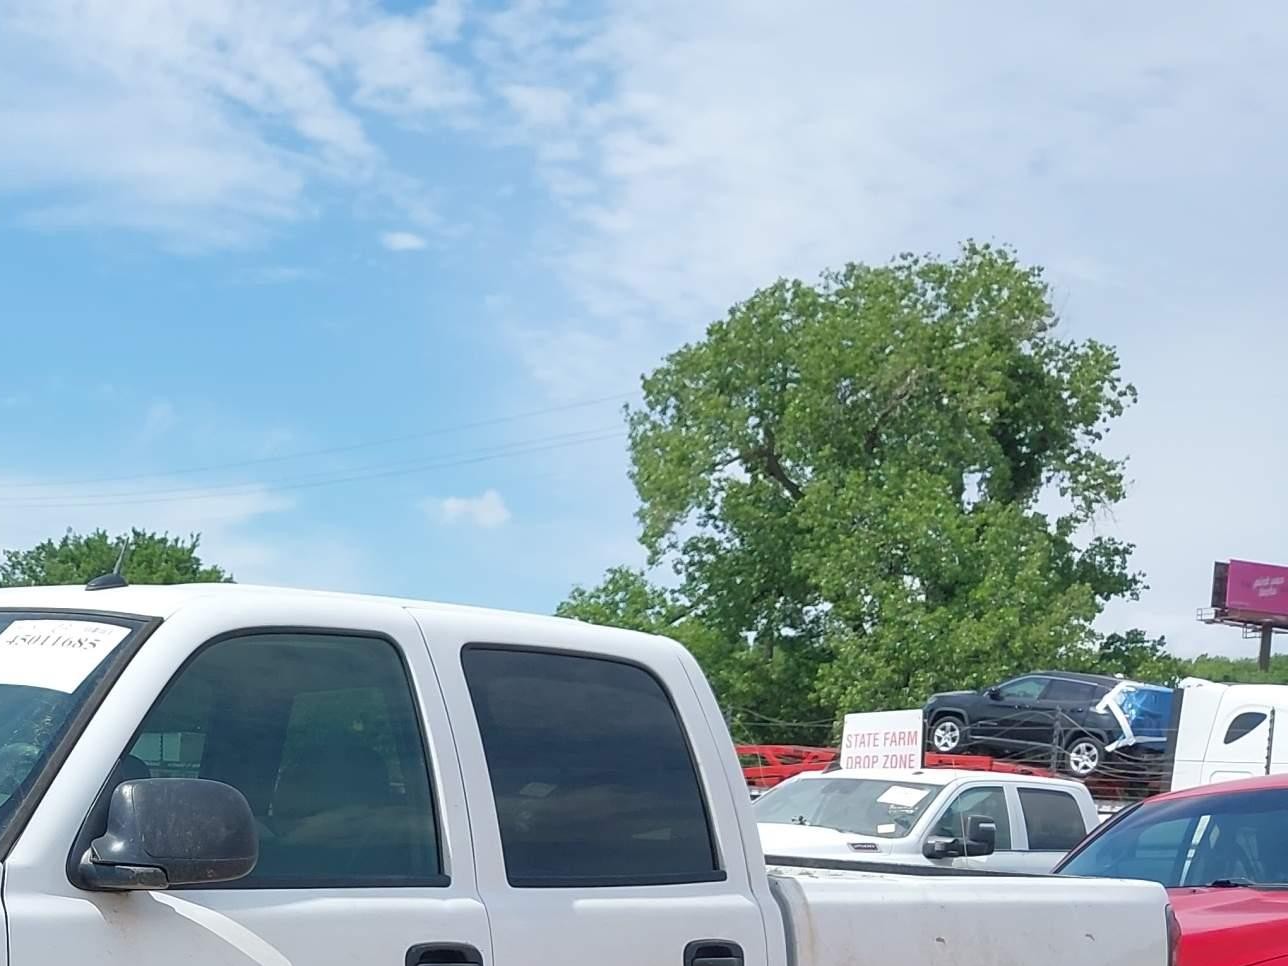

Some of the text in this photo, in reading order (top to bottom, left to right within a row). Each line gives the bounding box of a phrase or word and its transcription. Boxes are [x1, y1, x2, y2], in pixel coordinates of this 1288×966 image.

[5, 633, 101, 650] 45011685
[845, 730, 918, 749] STATE FARM
[846, 753, 916, 769] DROP ZONE
